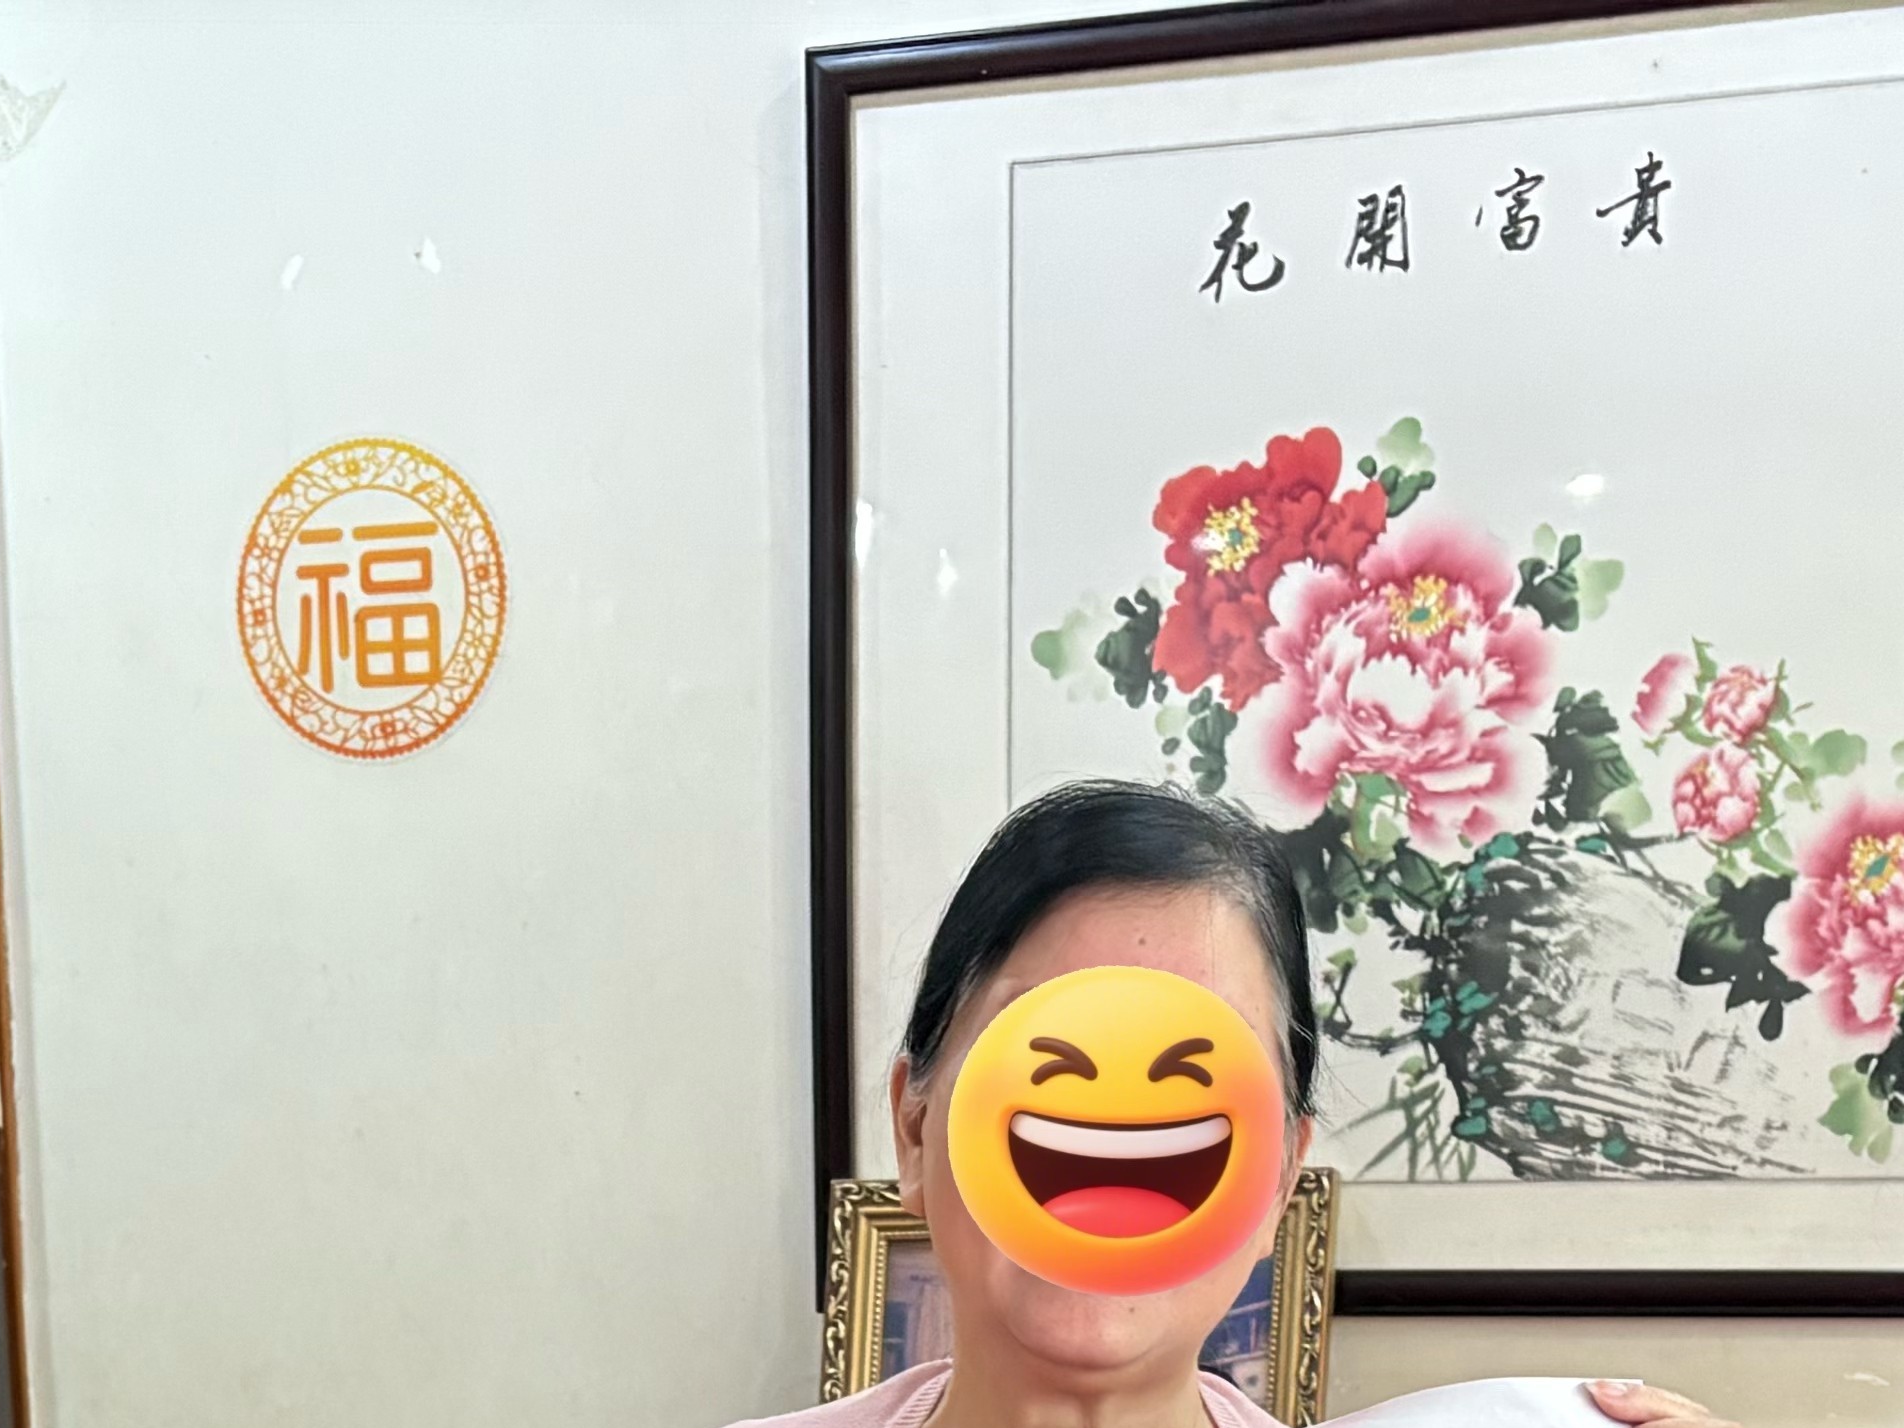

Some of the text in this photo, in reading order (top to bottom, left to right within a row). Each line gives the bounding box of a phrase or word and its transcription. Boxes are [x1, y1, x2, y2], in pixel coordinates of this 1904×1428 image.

[1199, 152, 1673, 303] 花開富貴
[295, 520, 443, 694] 福
